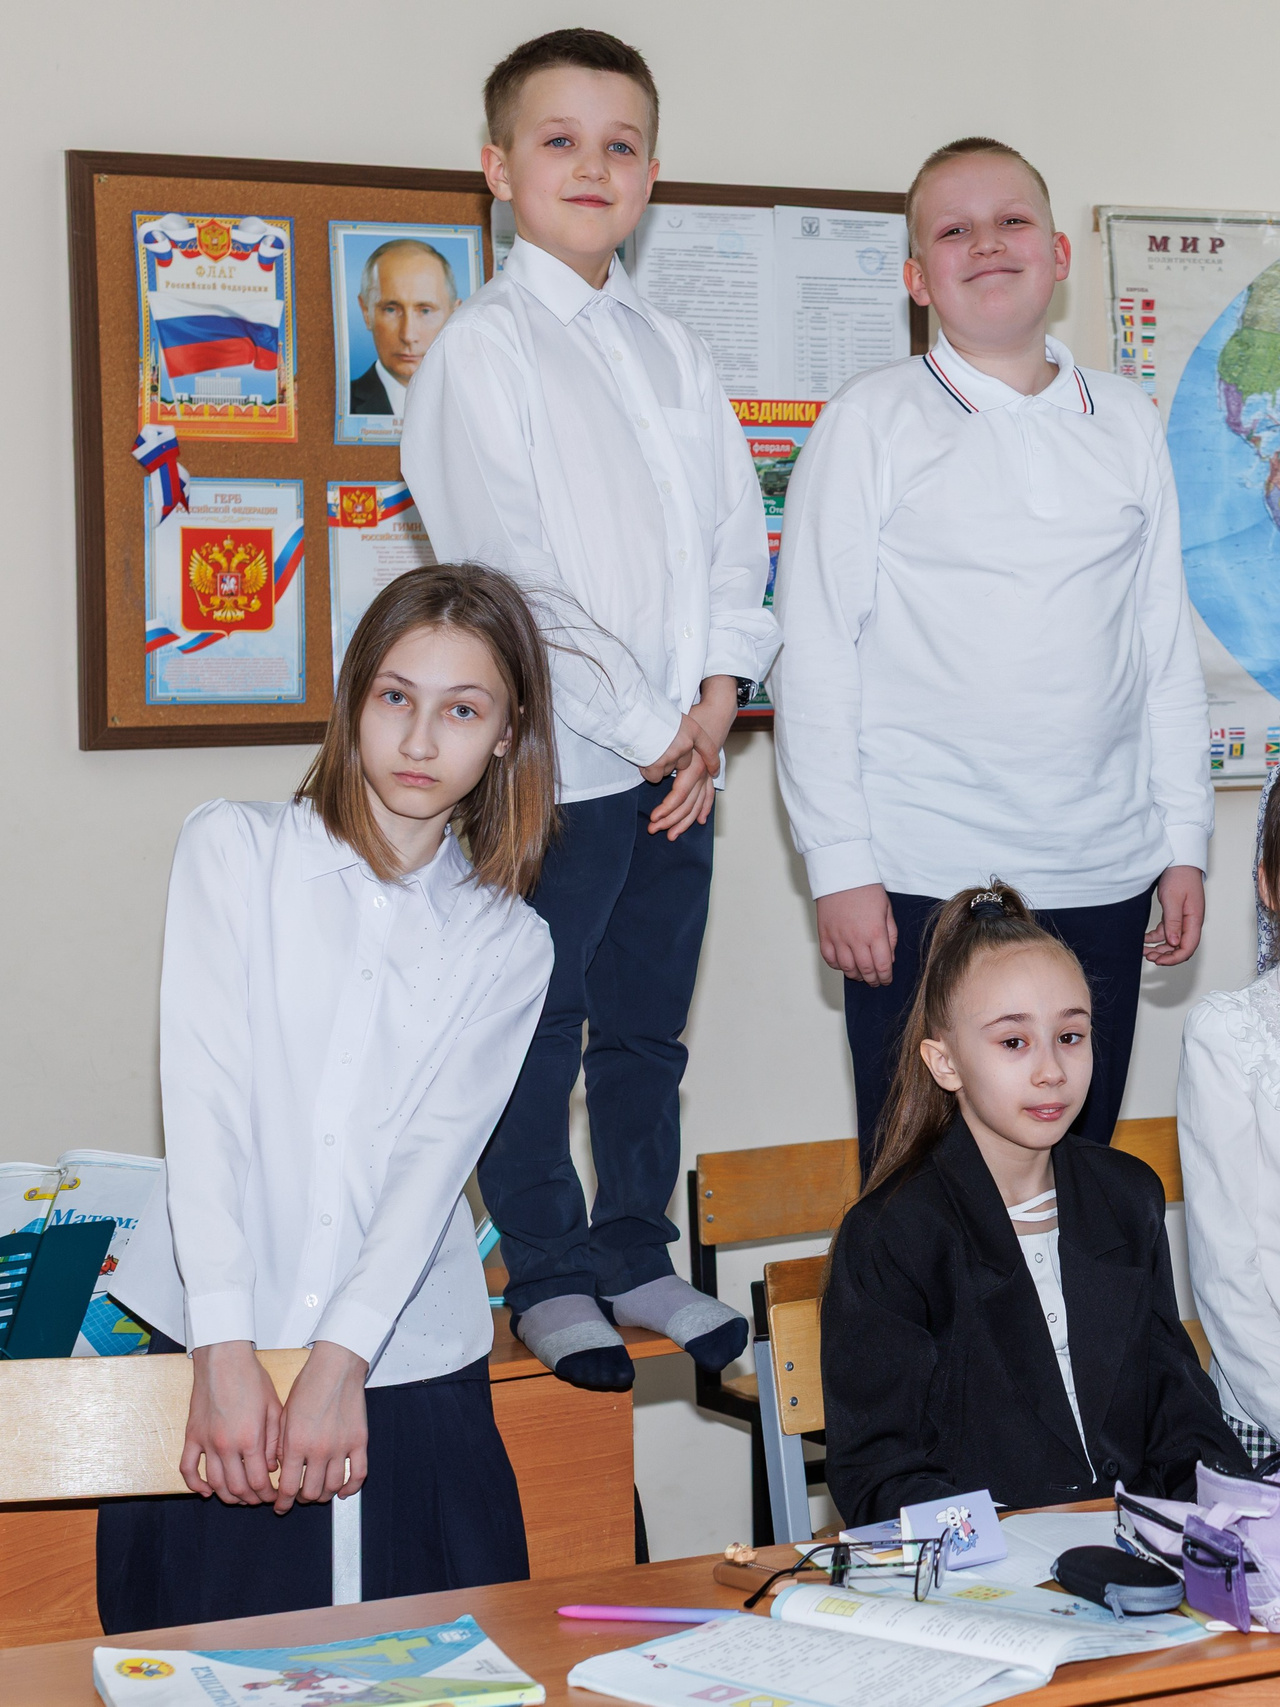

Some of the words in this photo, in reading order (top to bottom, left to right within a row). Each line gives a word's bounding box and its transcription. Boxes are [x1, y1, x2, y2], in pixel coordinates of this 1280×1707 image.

[1148, 235, 1225, 254] МИР
[195, 265, 236, 279] ФЛАГ
[731, 401, 816, 424] РАЗДНИКИ
[752, 442, 791, 454] февраля
[214, 493, 242, 504] ГЕРБ
[393, 522, 422, 531] ГИМН
